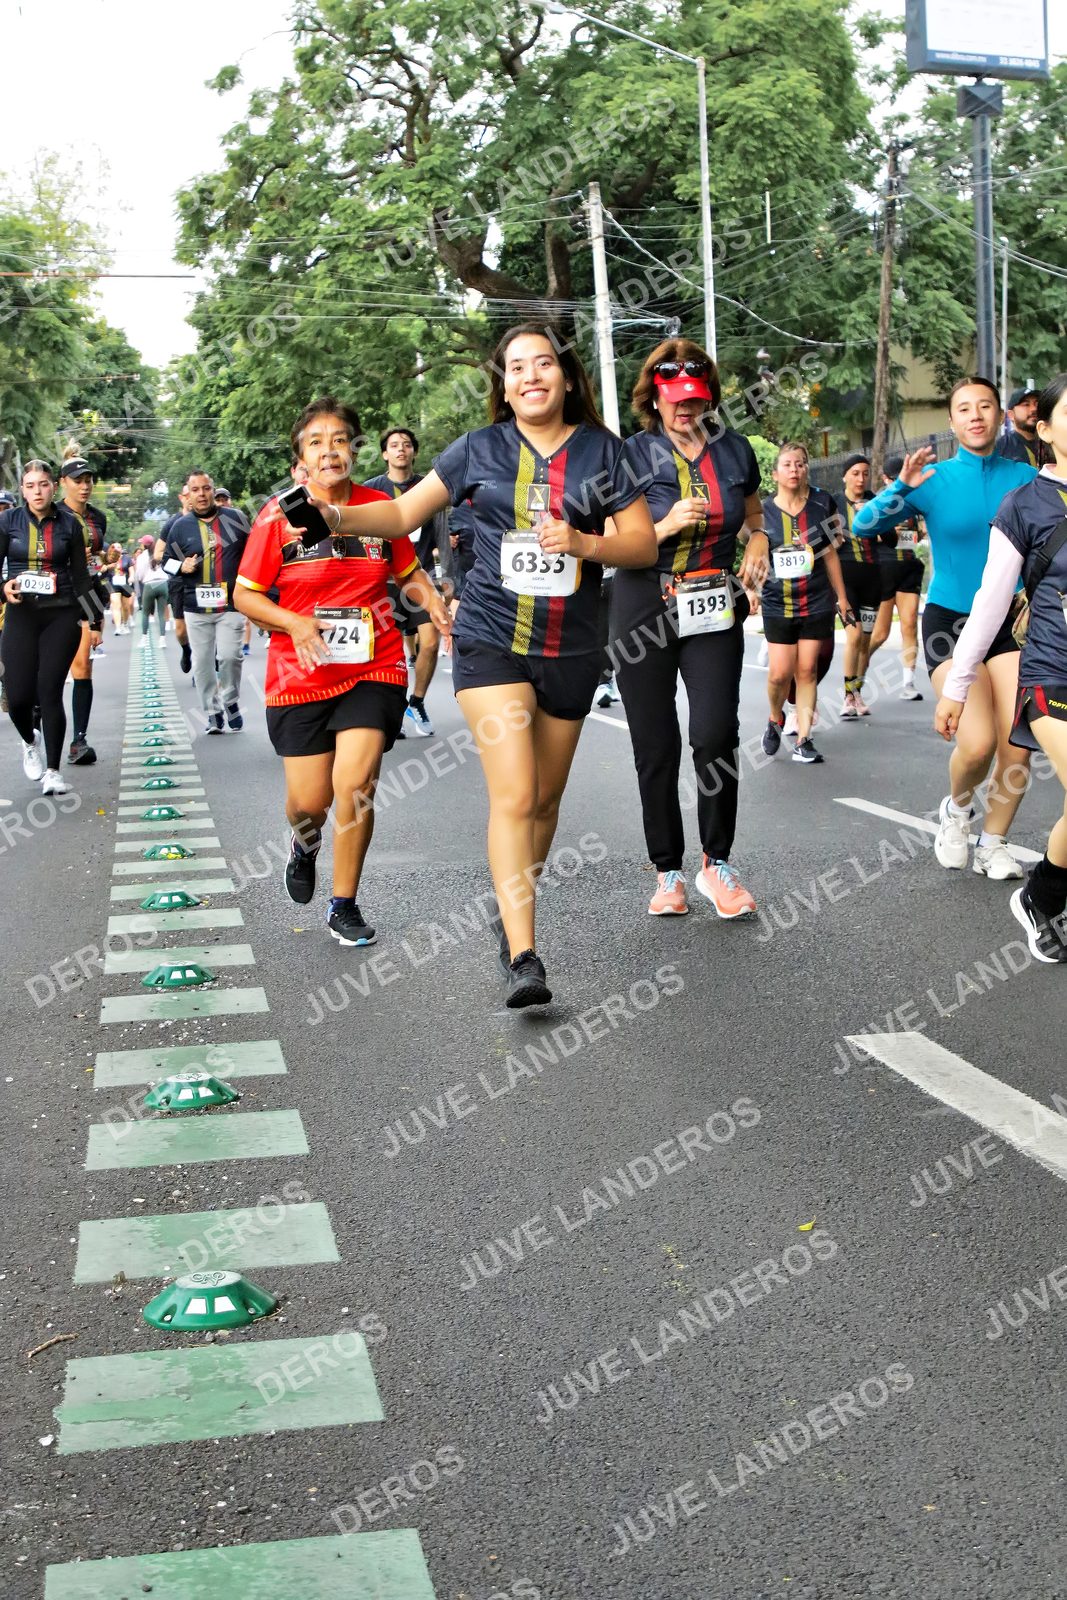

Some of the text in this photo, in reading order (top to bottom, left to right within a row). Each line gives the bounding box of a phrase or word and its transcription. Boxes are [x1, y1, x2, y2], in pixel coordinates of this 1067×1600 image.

[779, 555, 805, 567] 3819
[200, 591, 221, 599] 2318
[687, 594, 727, 617] 1393
[319, 625, 361, 645] 724
